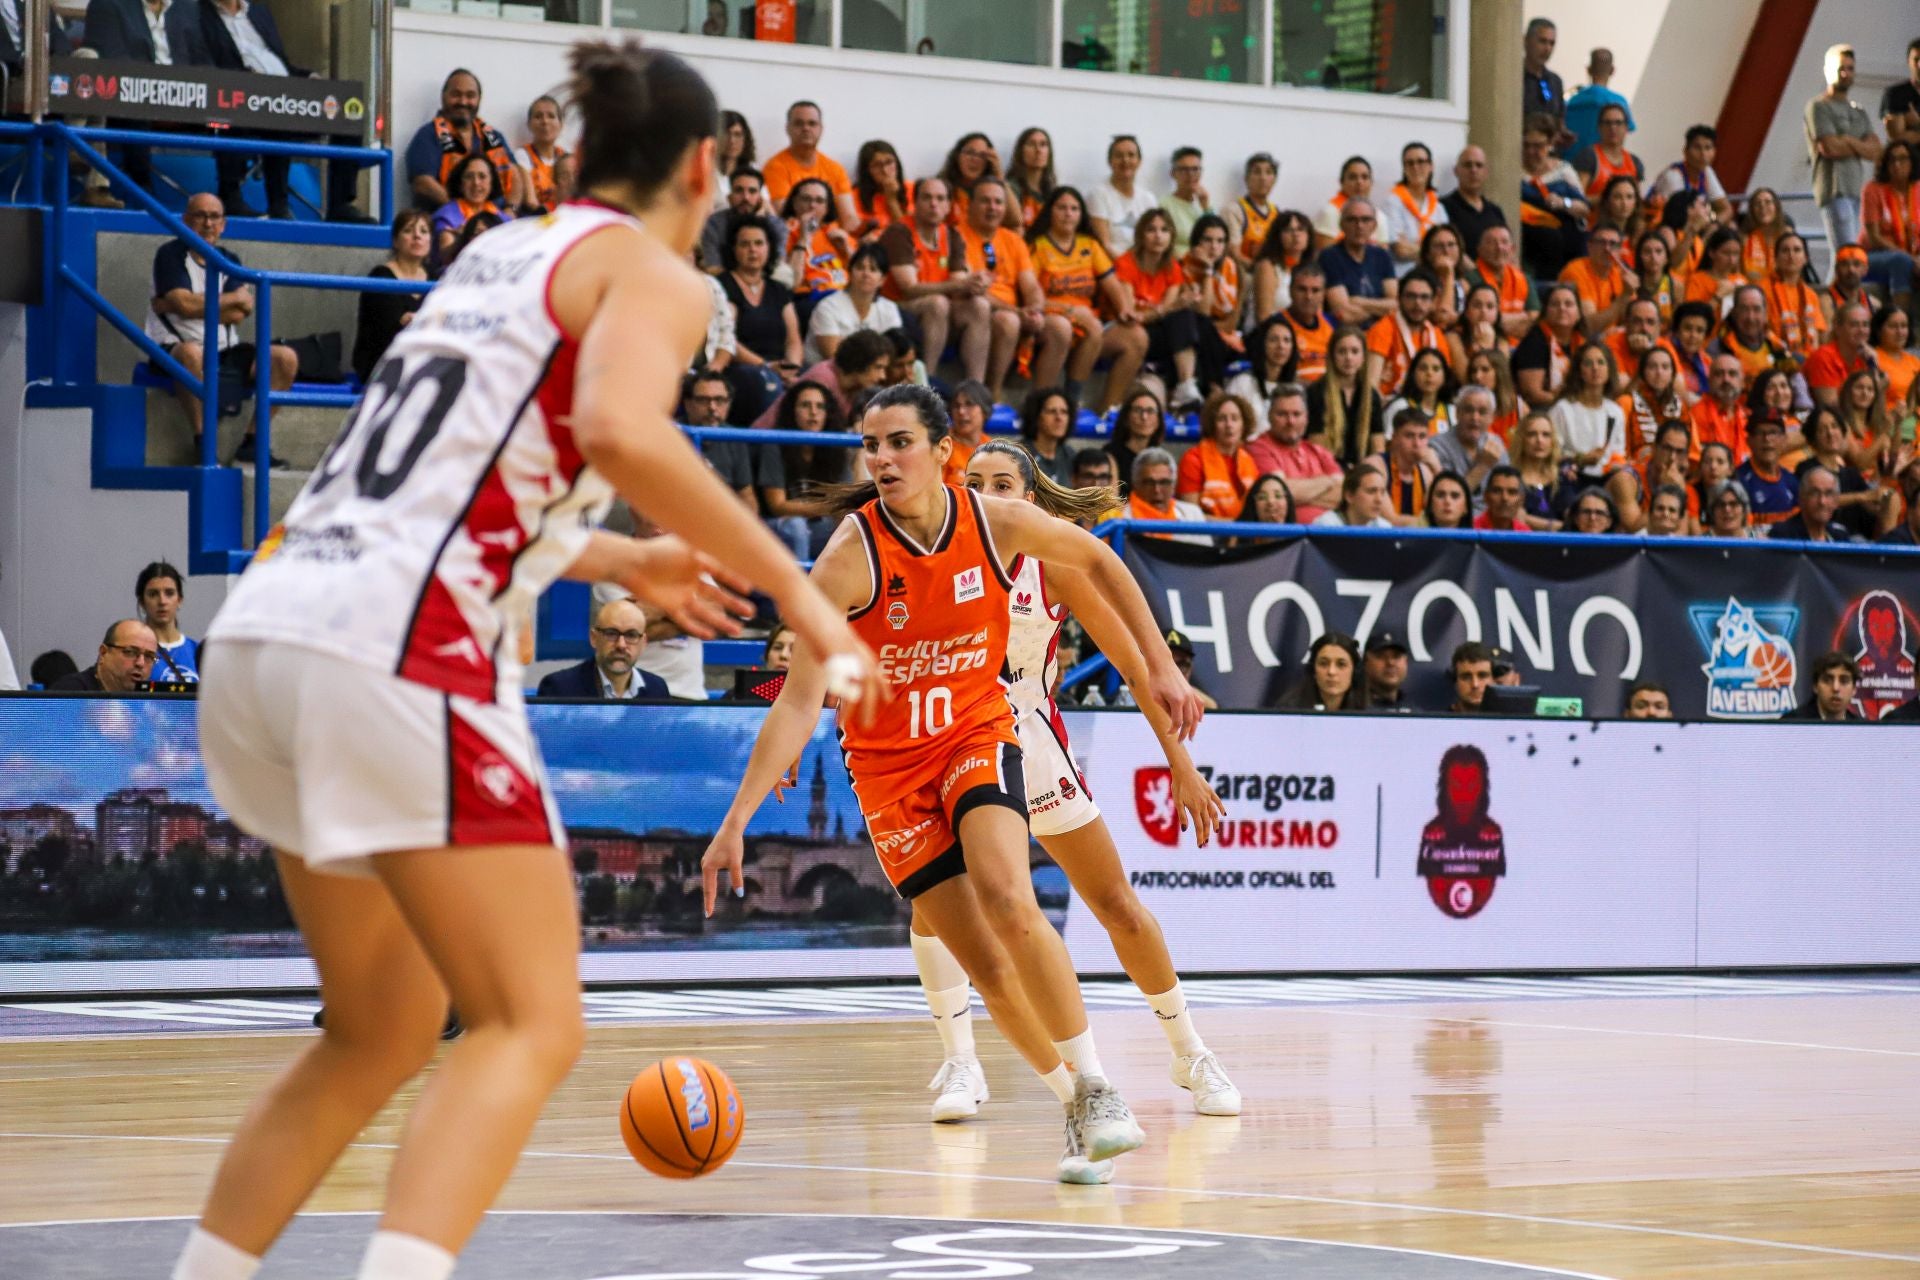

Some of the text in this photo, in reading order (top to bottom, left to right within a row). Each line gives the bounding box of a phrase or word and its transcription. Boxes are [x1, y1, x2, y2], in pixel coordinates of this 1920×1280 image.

[119, 75, 321, 117] SUPERCOPA LF endesa
[907, 686, 954, 739] 10
[1711, 686, 1794, 713] AVENIDA
[1200, 820, 1339, 849] URISMO
[1130, 870, 1336, 889] PATROCINADOR OFICIAL DEL
